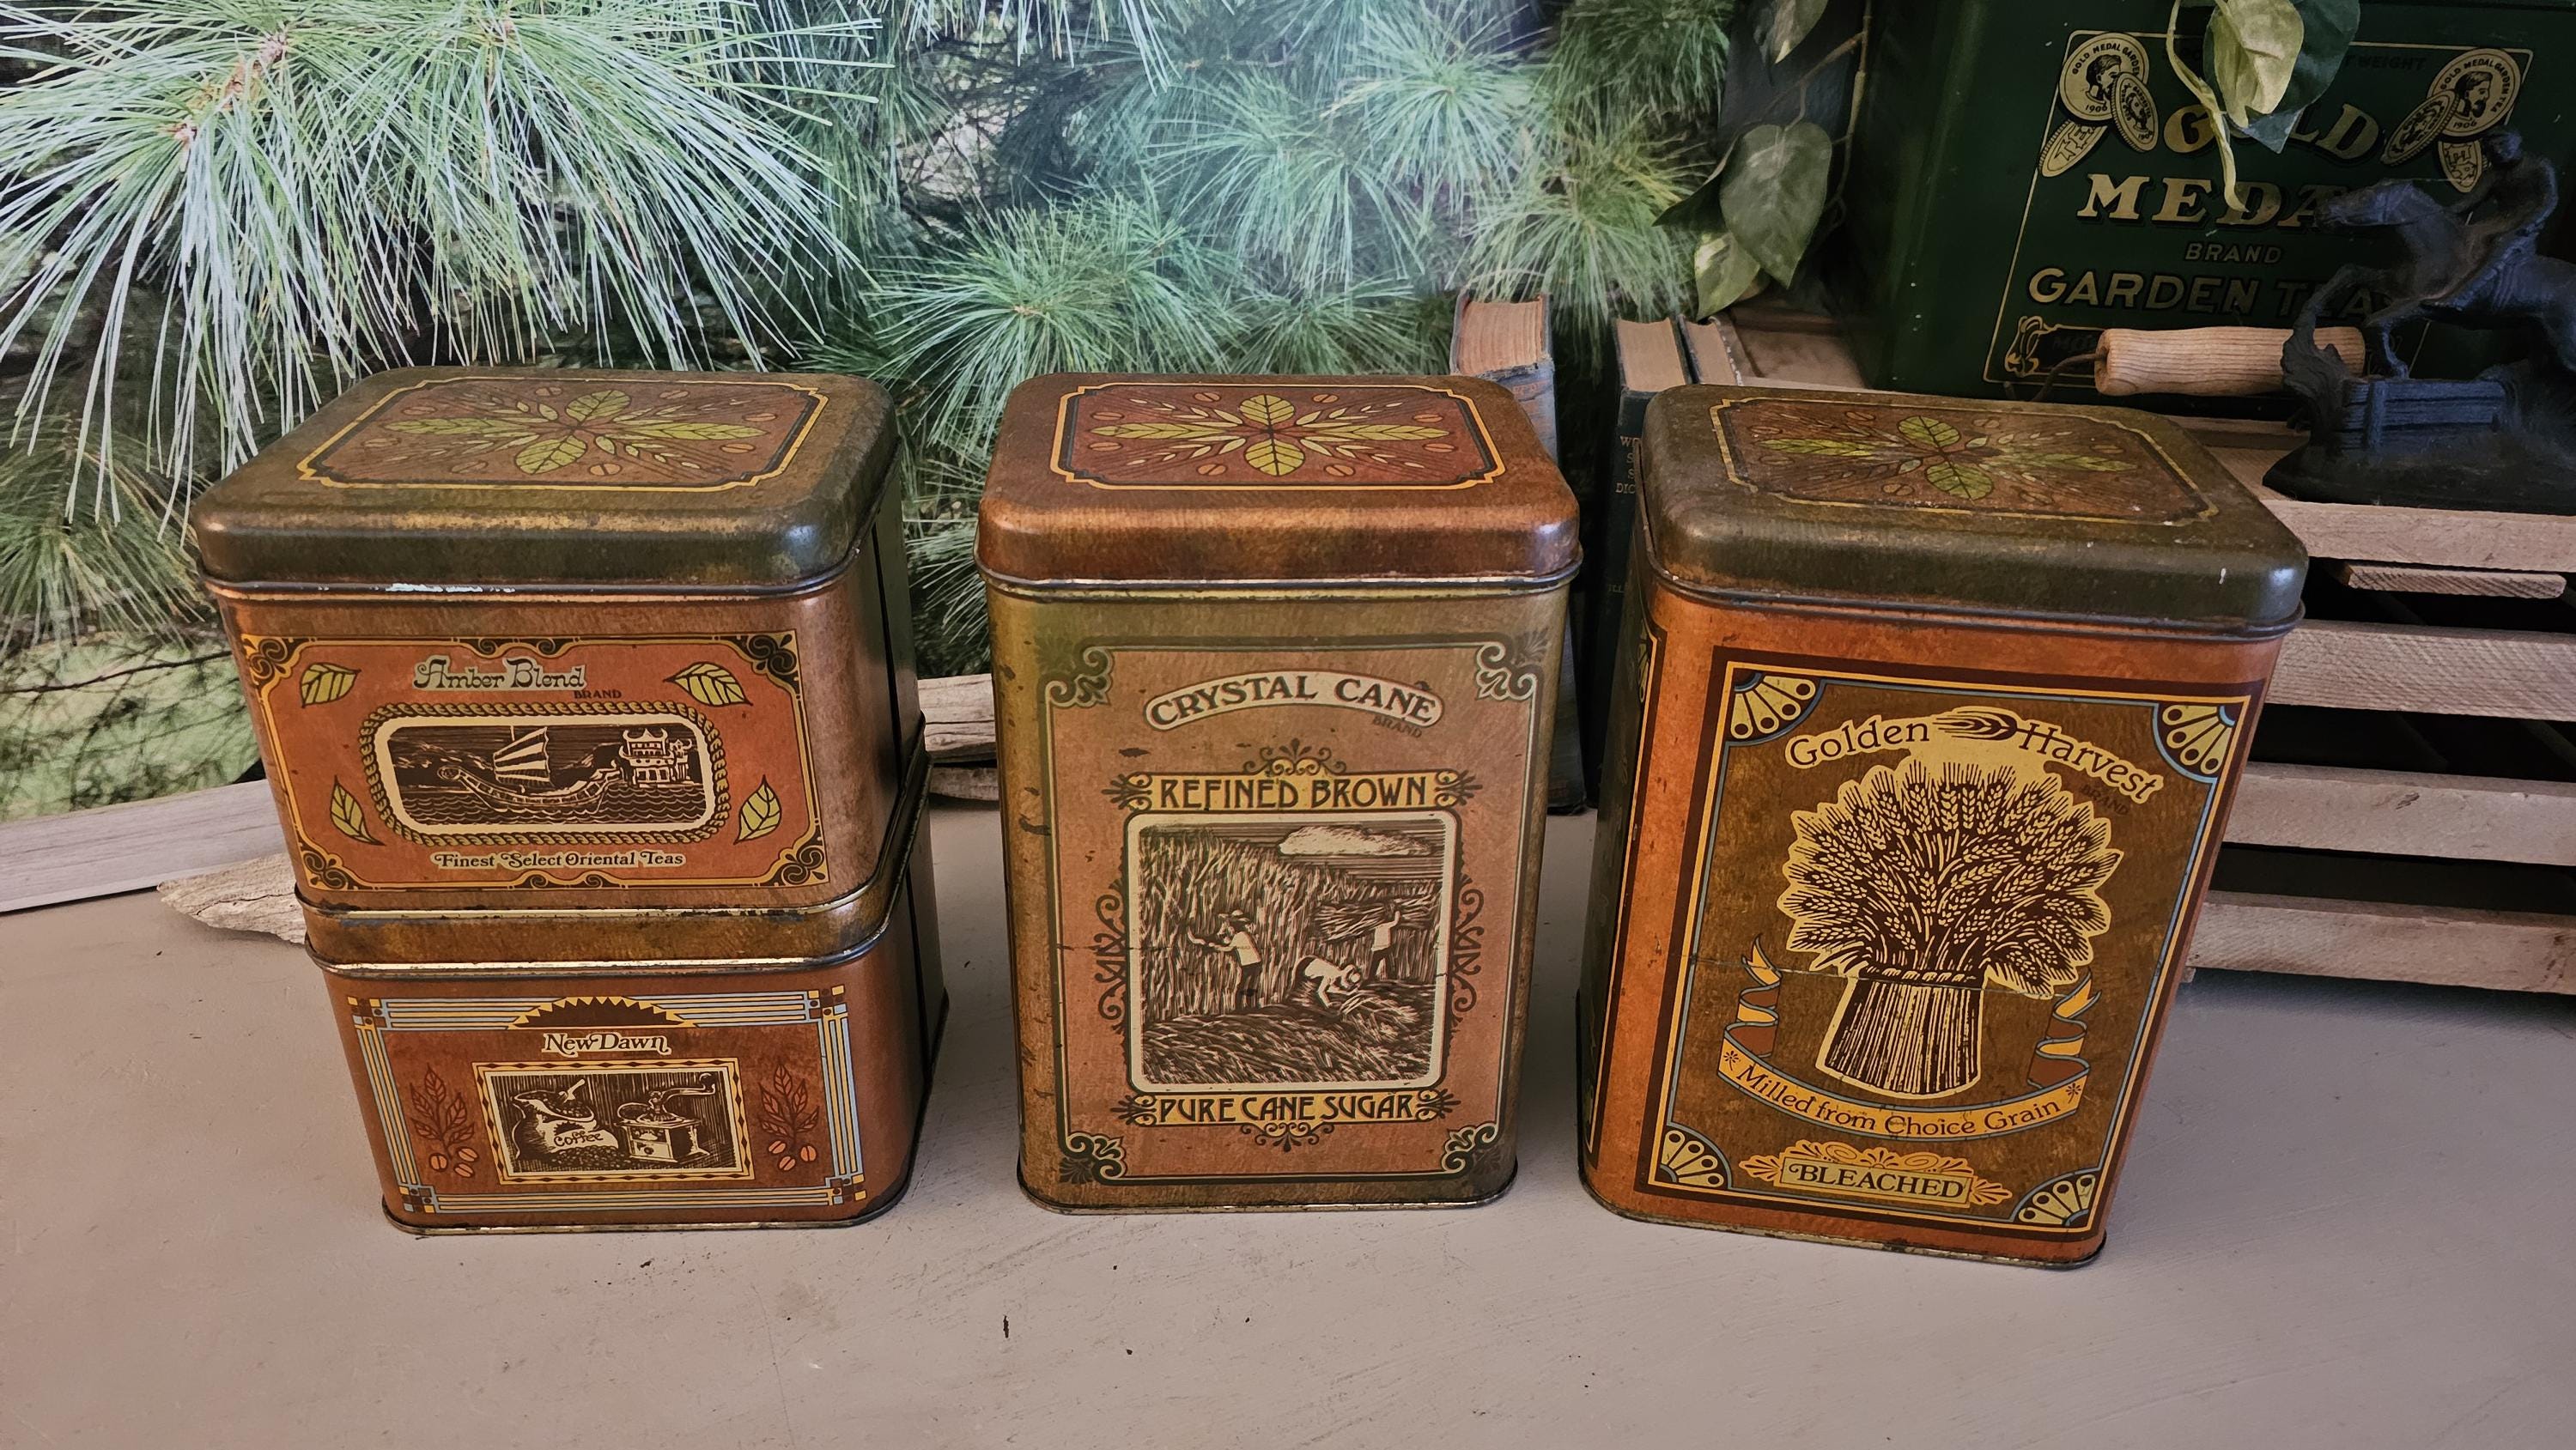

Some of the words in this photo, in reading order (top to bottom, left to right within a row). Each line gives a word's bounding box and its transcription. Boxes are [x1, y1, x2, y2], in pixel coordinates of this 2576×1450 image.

[2072, 52, 2090, 75] GOLD
[2093, 43, 2121, 53] MEDAL
[2464, 58, 2494, 69] MEDAL
[2439, 68, 2461, 90] GOLD
[2494, 63, 2511, 94] GARDEN
[2085, 104, 2108, 113] 1906
[2491, 96, 2506, 112] TEA
[2163, 102, 2380, 161] GD
[2076, 173, 2349, 228] MEDA
[2184, 241, 2282, 265] BRAND
[2027, 266, 2262, 317] GARDEN
[413, 658, 505, 689] Amber
[506, 658, 586, 689] Blend
[574, 689, 623, 700] BRAND
[1151, 675, 1319, 725] CRYSTAL
[1334, 677, 1437, 724] CANE
[1371, 715, 1423, 738] BRAND
[1789, 719, 1930, 767] Golden
[2018, 720, 2157, 801] Harvest
[1159, 778, 1299, 810] REFINED
[1310, 776, 1427, 809] BROWN
[434, 852, 495, 868] Finest
[500, 852, 562, 868] Select
[565, 852, 635, 866] Oriental
[640, 851, 683, 865] Teas
[1159, 1097, 1236, 1123] PURE
[1241, 1095, 1315, 1122] CANE
[1320, 1094, 1414, 1121] SUGAR
[1735, 1065, 1815, 1114] Milled
[1816, 1100, 1876, 1131] from
[1885, 1116, 1976, 1136] Choice
[1984, 1101, 2062, 1131] Grain
[553, 1131, 605, 1148] Coffee
[1788, 1162, 1964, 1199] BLEACHED
